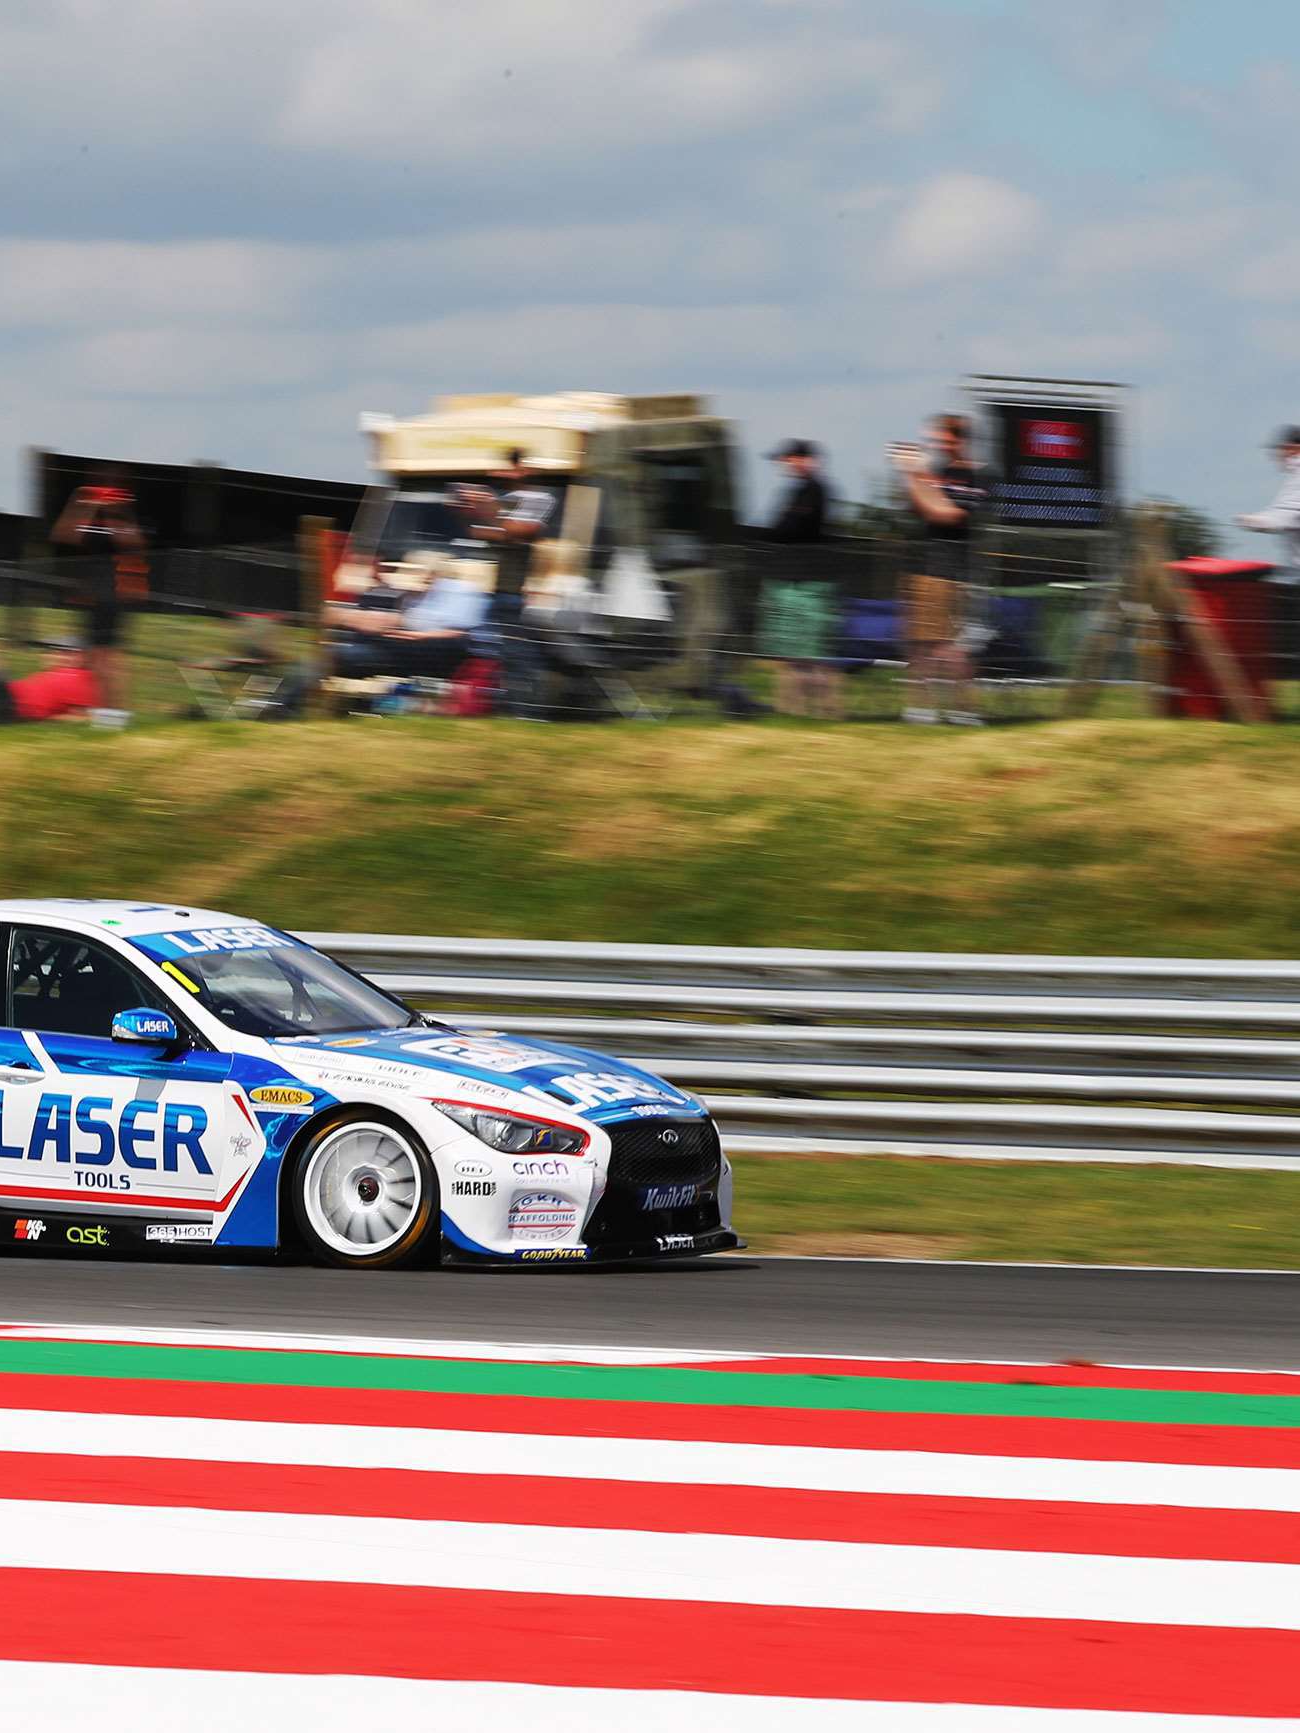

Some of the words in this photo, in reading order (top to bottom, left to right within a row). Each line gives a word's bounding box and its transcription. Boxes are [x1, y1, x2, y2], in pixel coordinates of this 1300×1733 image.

[163, 927, 296, 954] LASER
[160, 961, 201, 994] 1
[136, 1020, 170, 1033] LASER
[260, 1089, 303, 1104] EMACS
[512, 1160, 569, 1176] cinch
[73, 1170, 131, 1190] TOOLS
[456, 1181, 491, 1196] HARD
[508, 1213, 577, 1223] SCAFFOLDING
[521, 1248, 587, 1260] GOODYEAR
